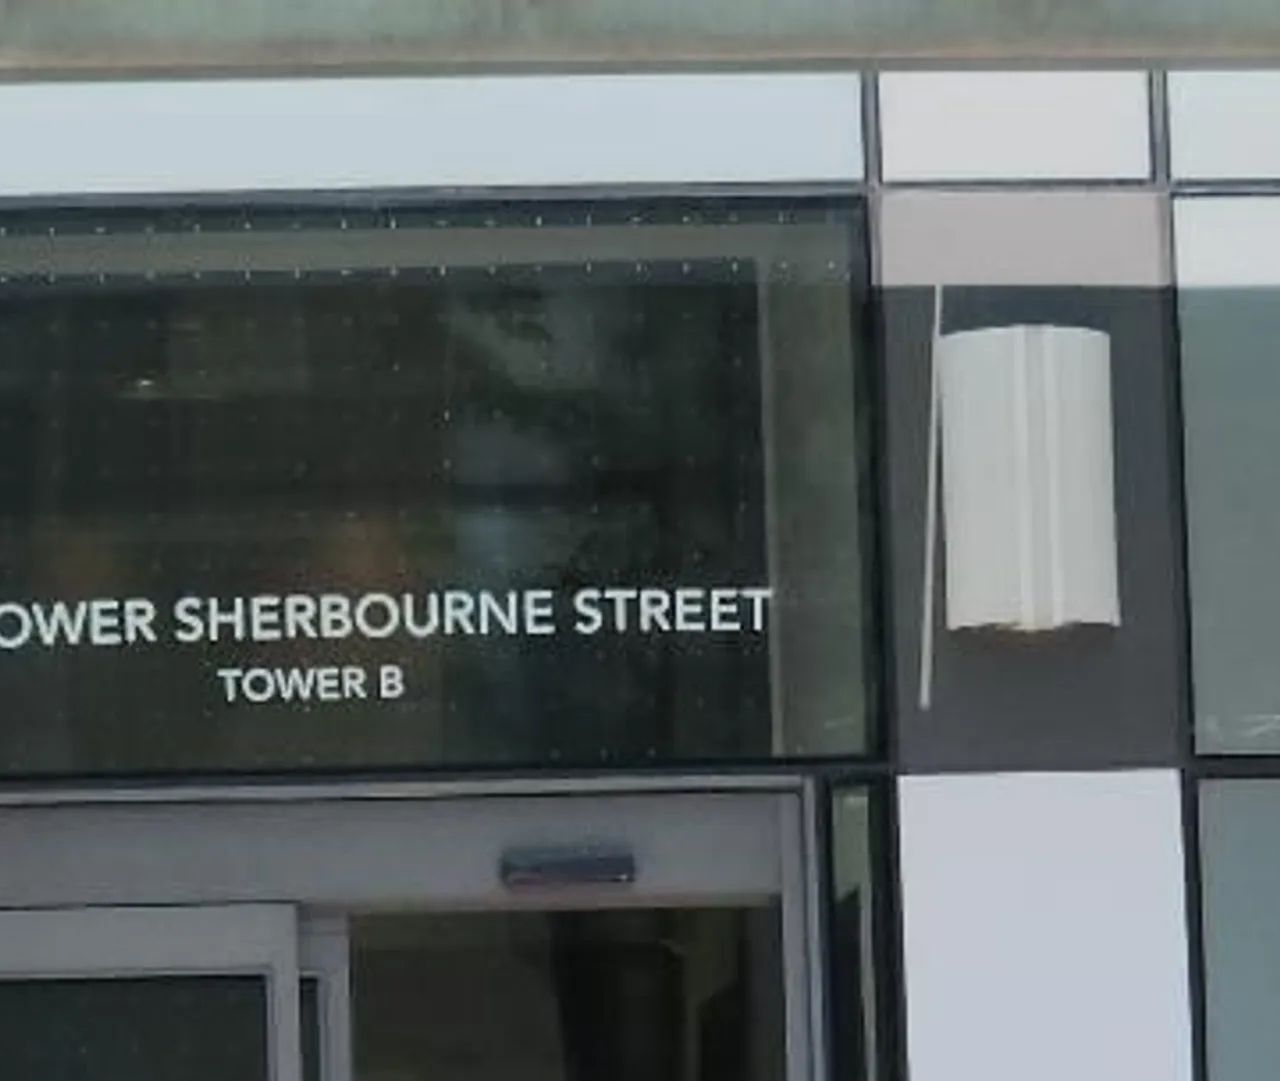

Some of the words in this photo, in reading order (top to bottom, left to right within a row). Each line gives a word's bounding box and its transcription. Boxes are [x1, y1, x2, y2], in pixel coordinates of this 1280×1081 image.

[173, 589, 557, 644] SHERBOURNE
[573, 586, 774, 636] STREET
[217, 667, 366, 702] TOWER
[378, 664, 405, 700] B
